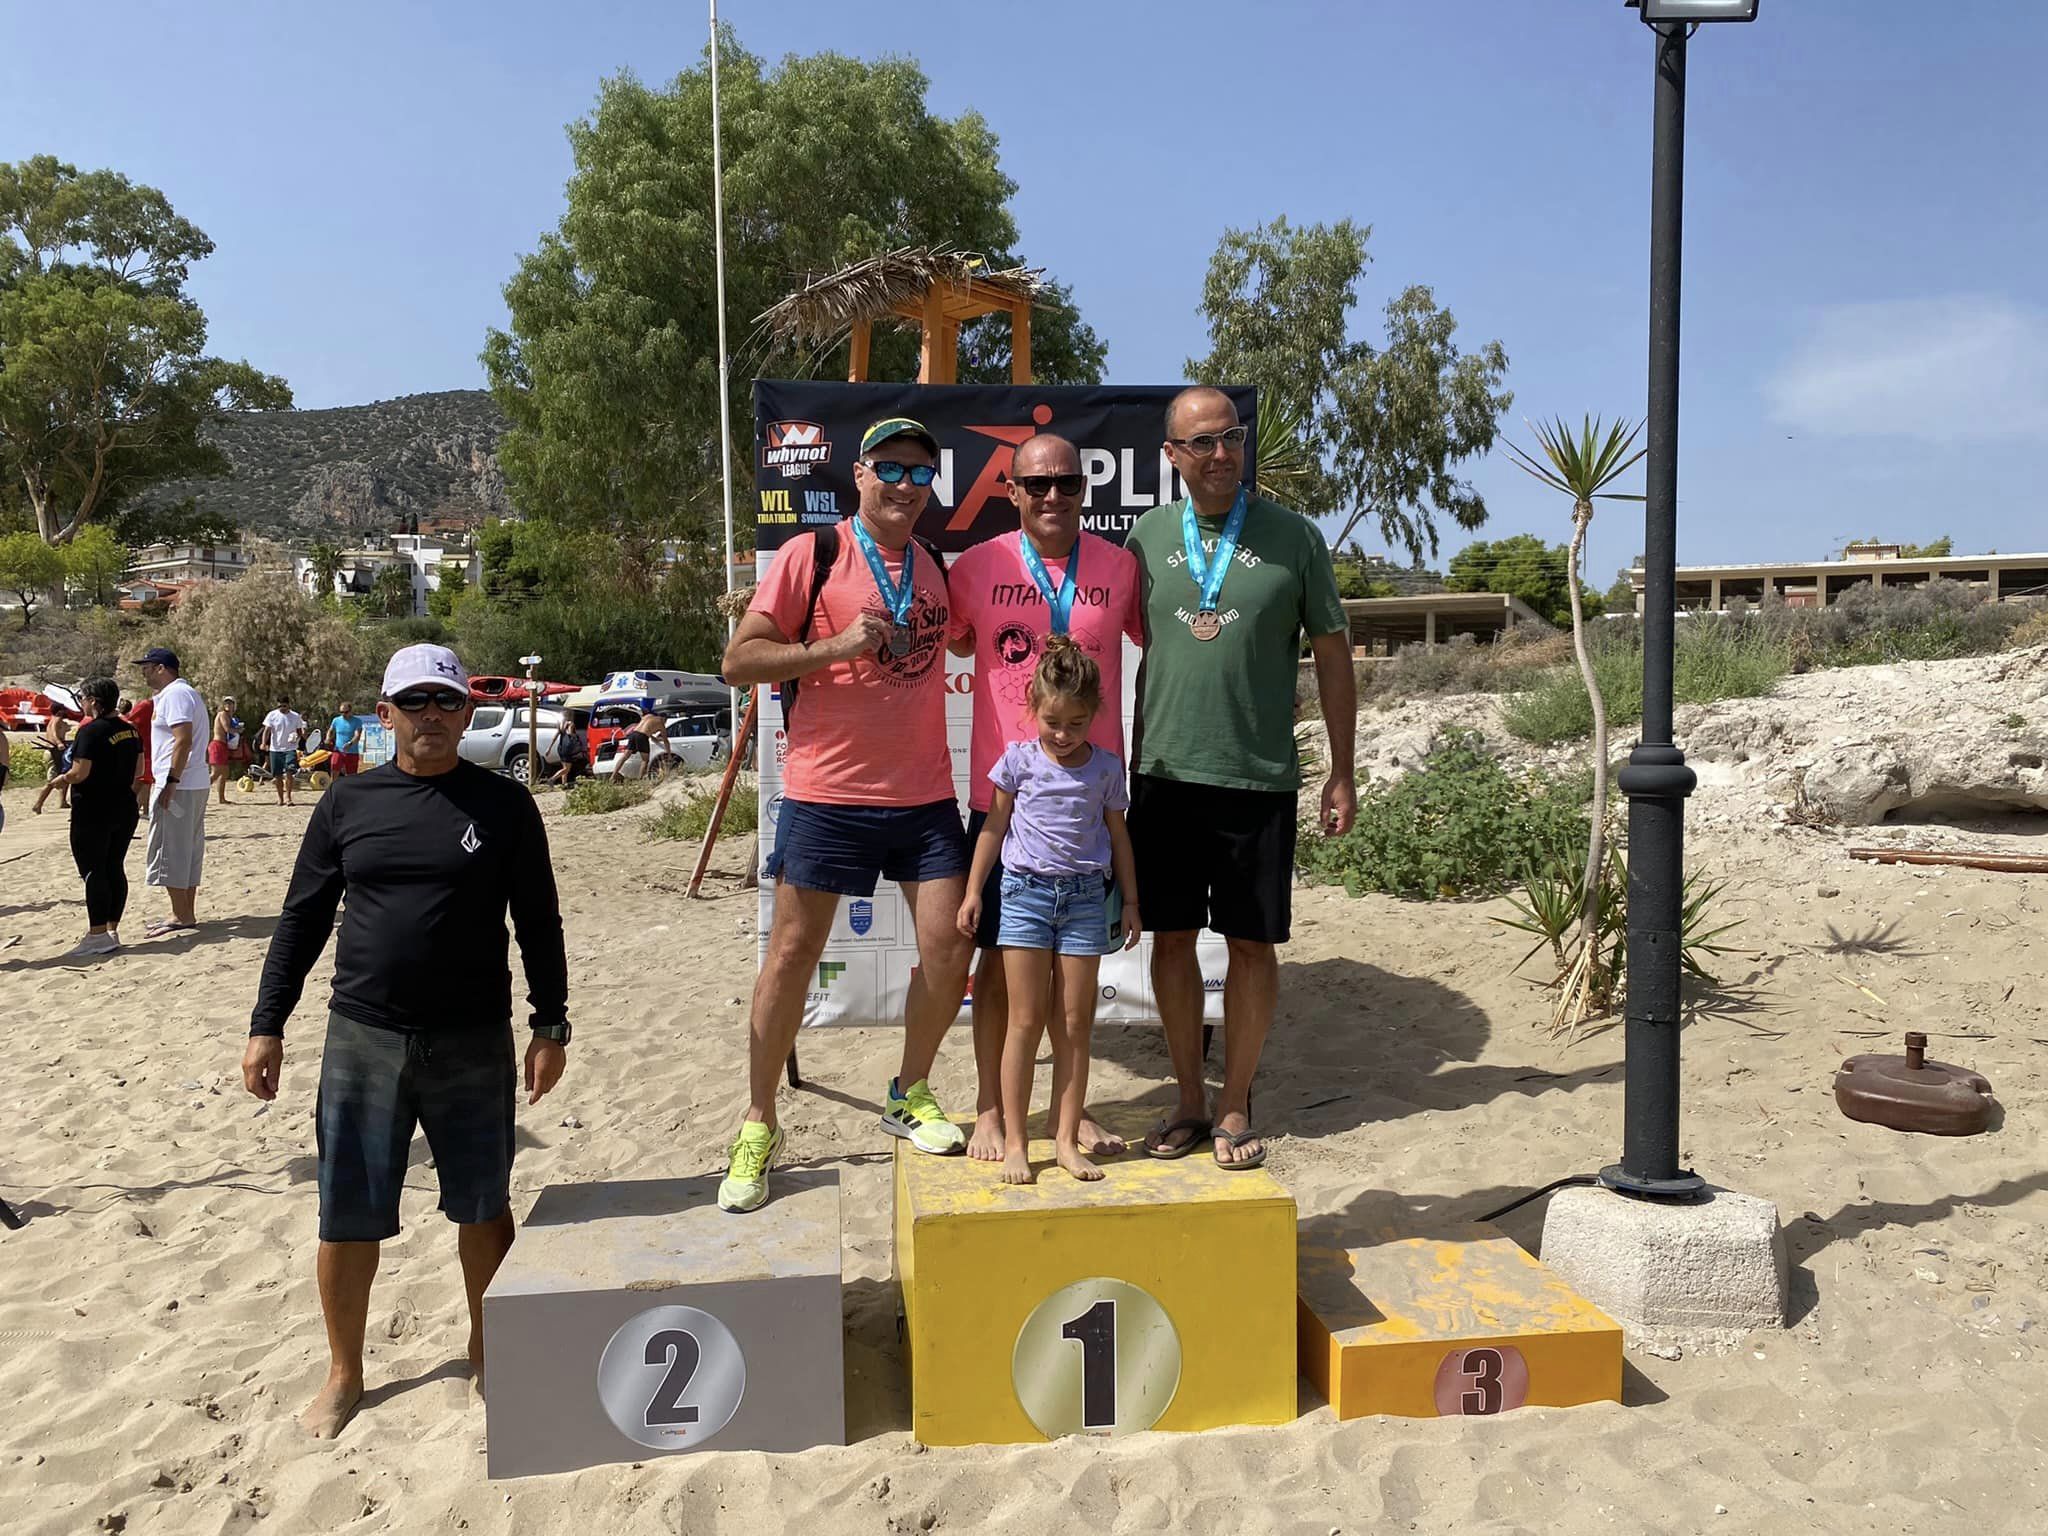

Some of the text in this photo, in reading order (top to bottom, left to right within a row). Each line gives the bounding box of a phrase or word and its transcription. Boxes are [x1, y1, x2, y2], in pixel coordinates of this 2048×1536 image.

[767, 446, 828, 464] whynot
[782, 463, 811, 477] LEAGUE
[760, 490, 792, 511] WTL
[804, 491, 839, 512] WSL
[757, 513, 797, 523] TRIATHLON
[807, 993, 831, 1001] EFIT
[1061, 1299, 1116, 1429] 1
[643, 1328, 701, 1427] 2
[1460, 1347, 1504, 1416] 3
